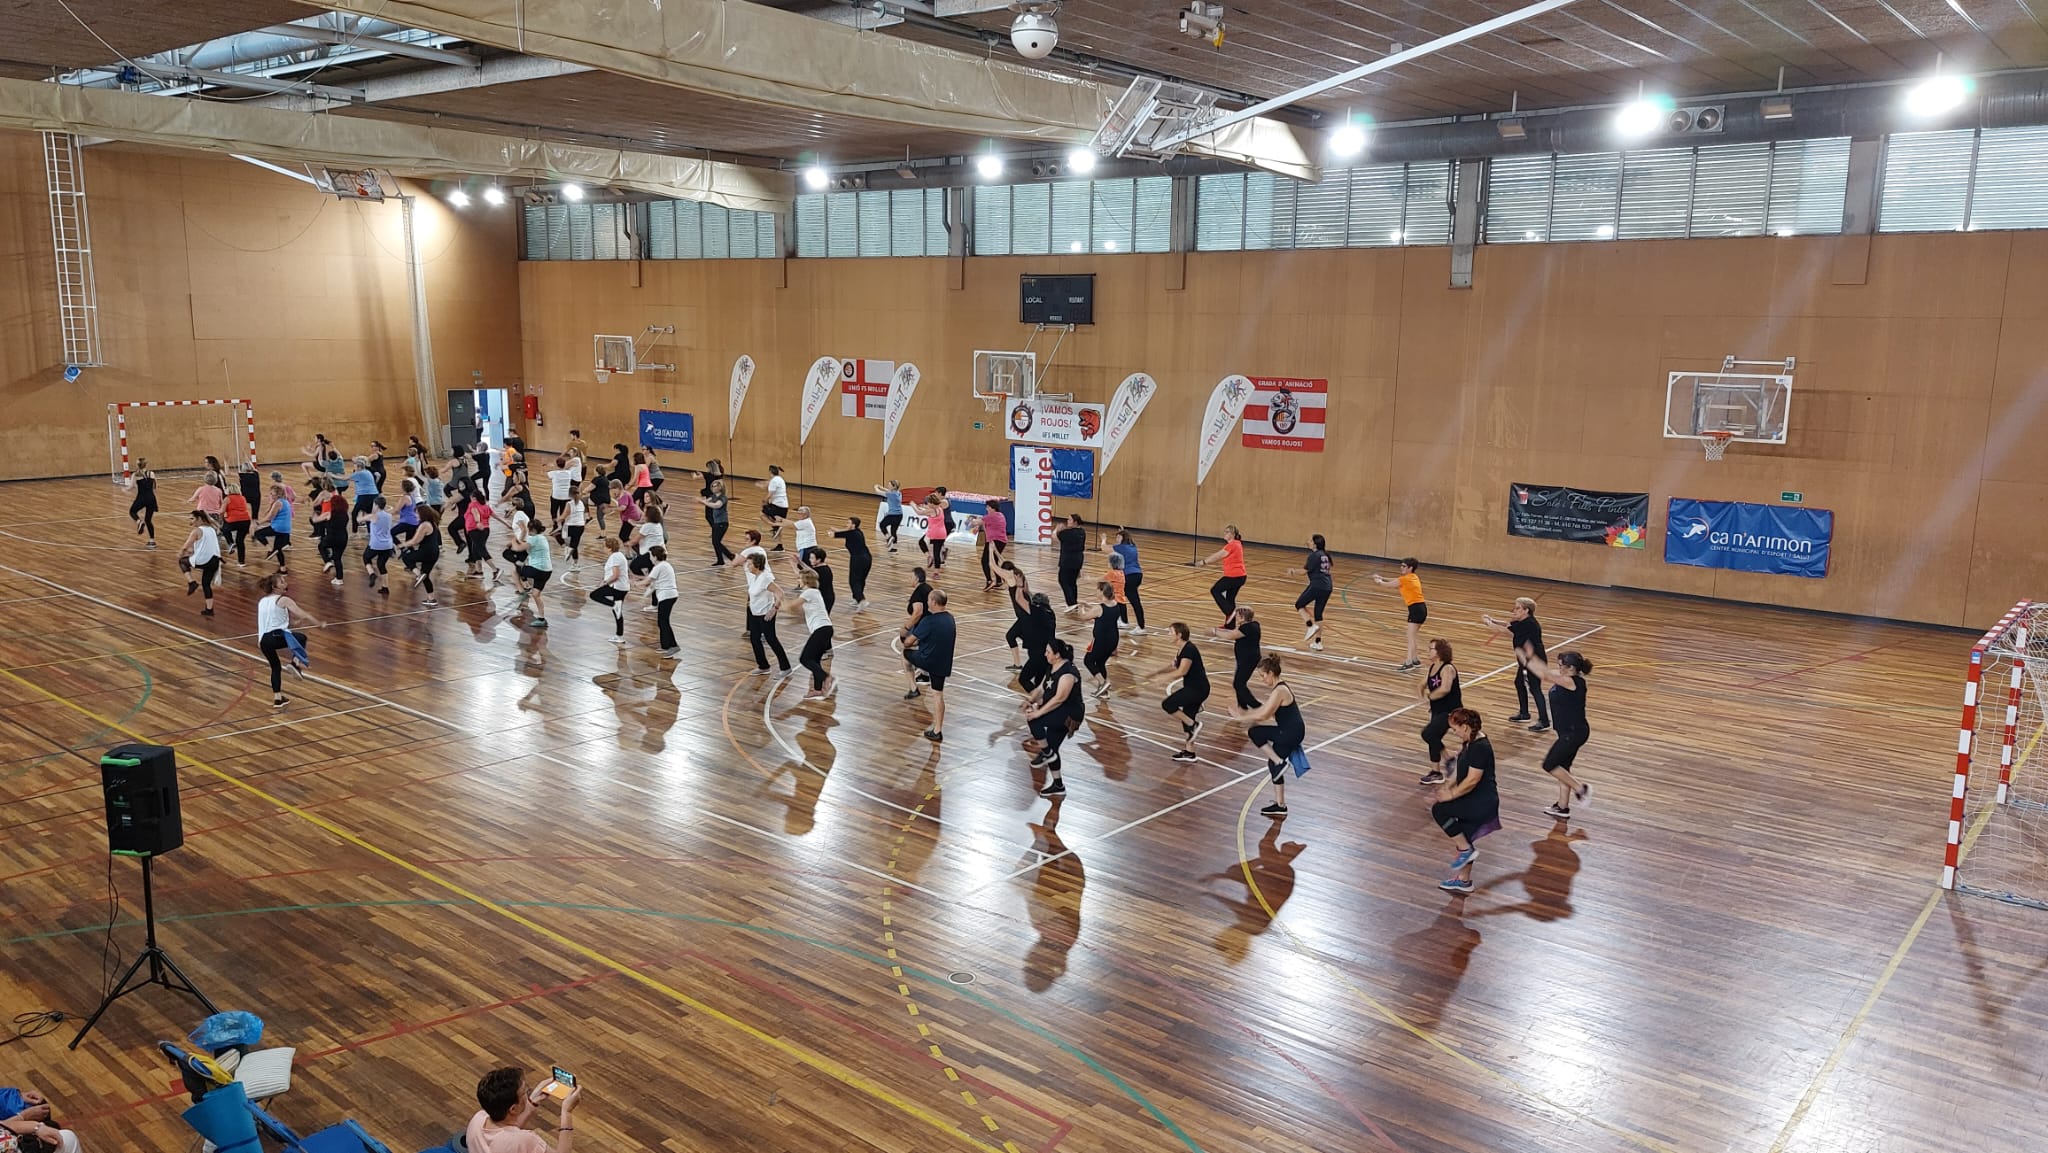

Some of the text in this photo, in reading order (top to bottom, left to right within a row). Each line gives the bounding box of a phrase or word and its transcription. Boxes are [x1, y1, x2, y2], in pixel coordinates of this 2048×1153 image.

[1025, 296, 1043, 304] LOCAL
[1041, 404, 1073, 416] ¡VAMOS
[1040, 417, 1072, 429] ROJOS!
[1052, 432, 1070, 440] MOLLET
[1034, 448, 1052, 542] mou-te!
[1731, 547, 1760, 555] MUNICIPAL
